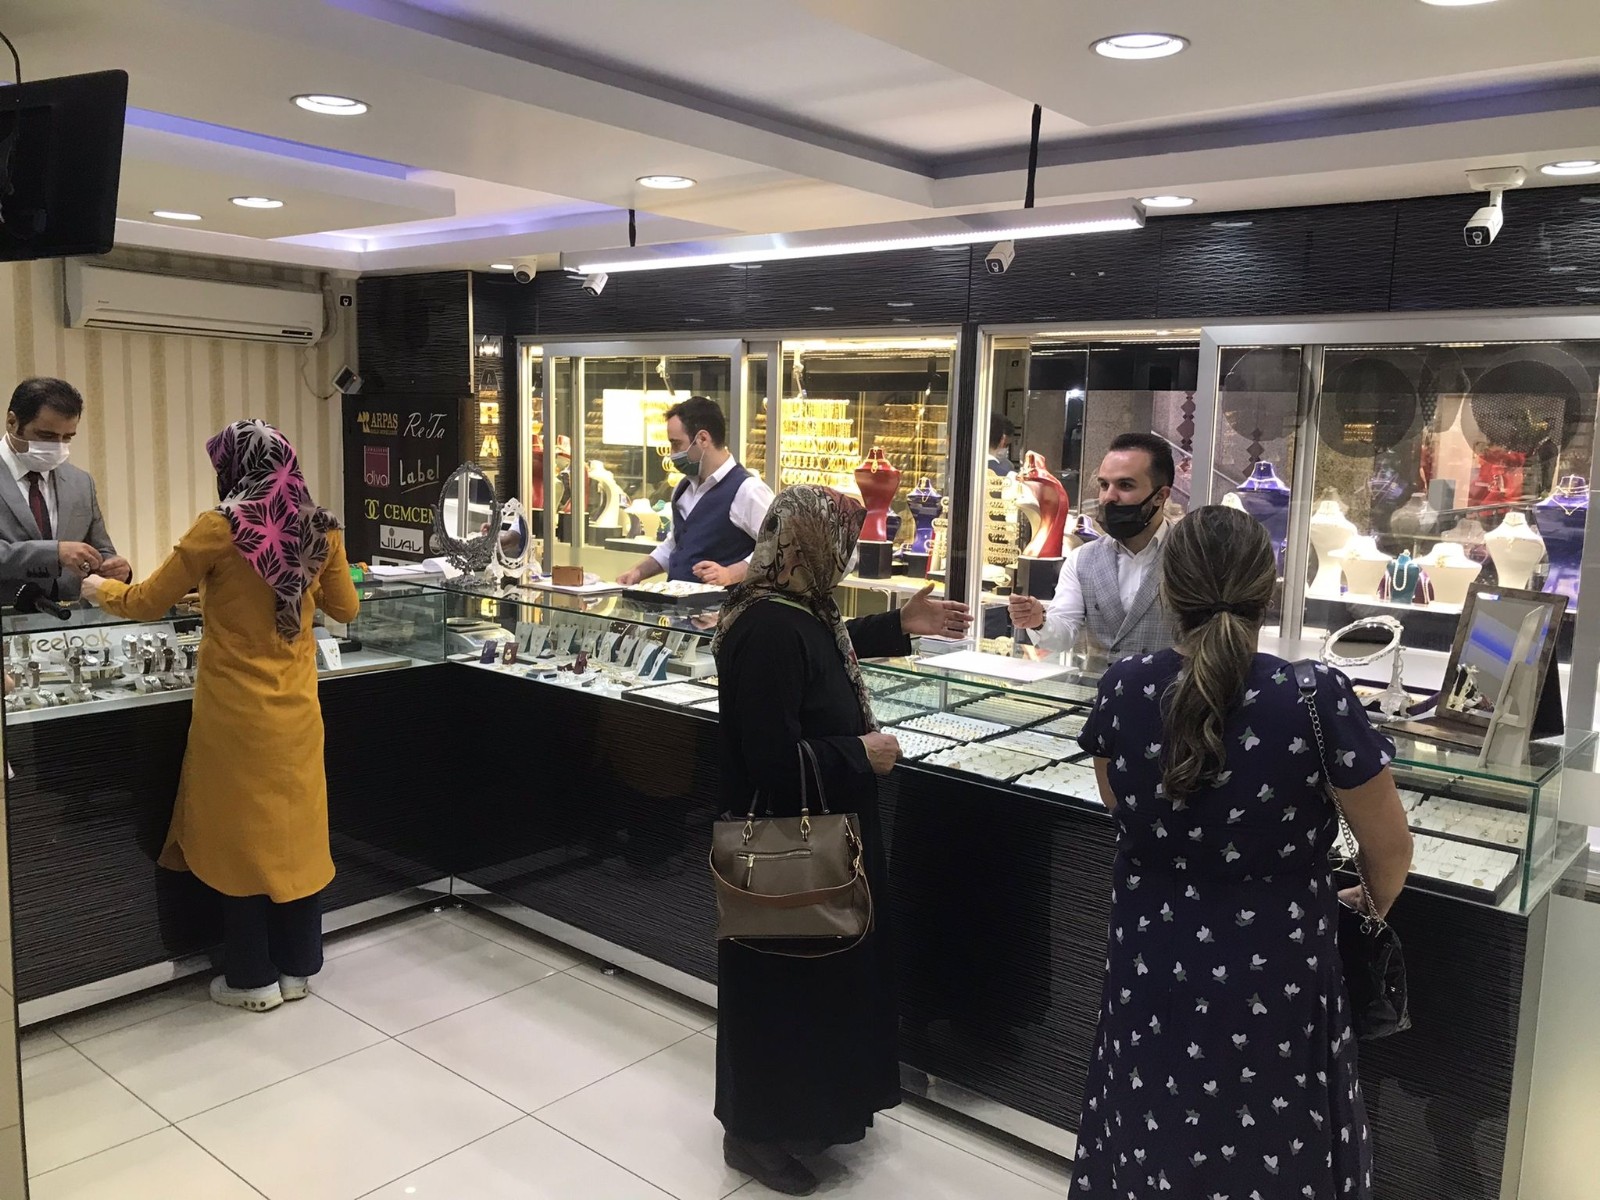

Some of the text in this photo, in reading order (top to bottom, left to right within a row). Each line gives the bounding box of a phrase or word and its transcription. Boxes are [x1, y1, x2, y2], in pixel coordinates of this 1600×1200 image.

[366, 470, 388, 487] diva
[399, 454, 440, 486] Label
[29, 629, 113, 654] reelook
